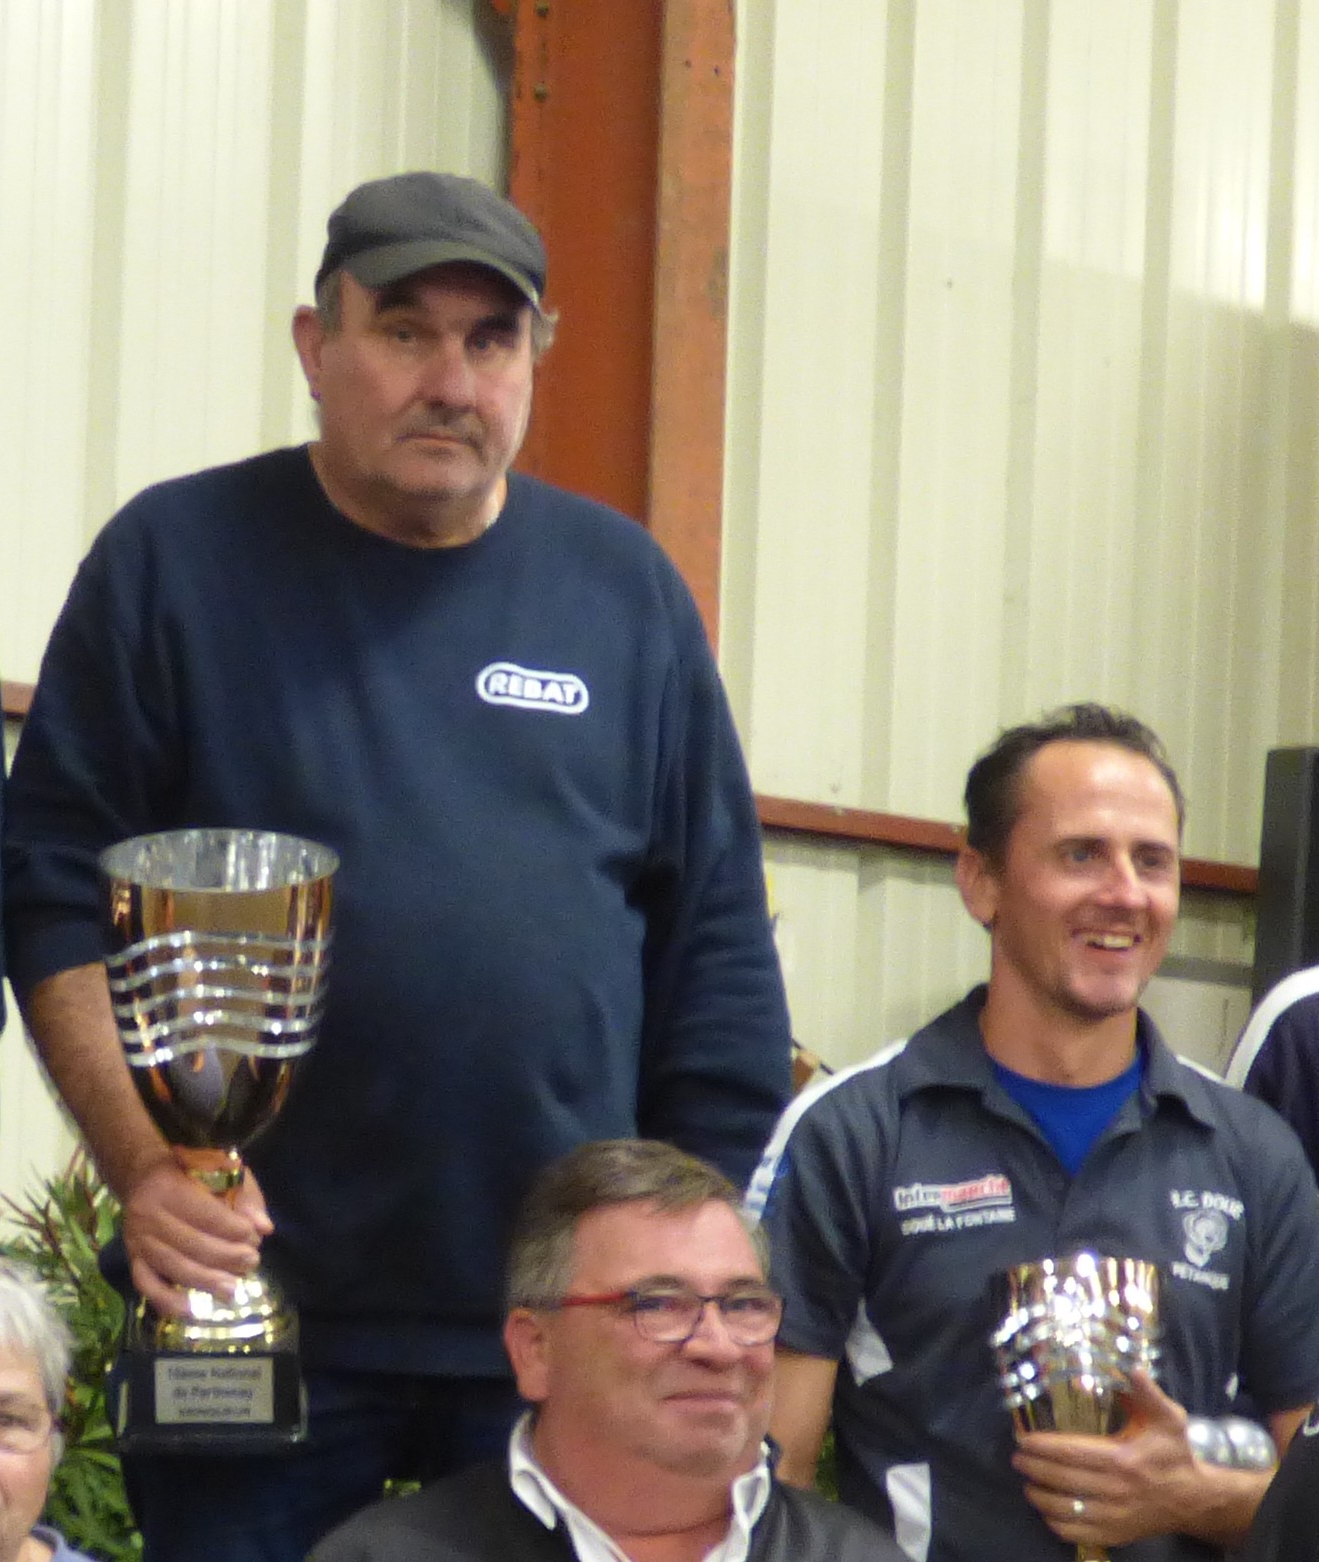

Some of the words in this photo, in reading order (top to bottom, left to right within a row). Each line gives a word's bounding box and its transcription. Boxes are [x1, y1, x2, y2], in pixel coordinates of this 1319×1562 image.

[488, 671, 580, 705] REBAT
[938, 1216, 955, 1231] LA
[956, 1206, 1016, 1229] FONTAINE
